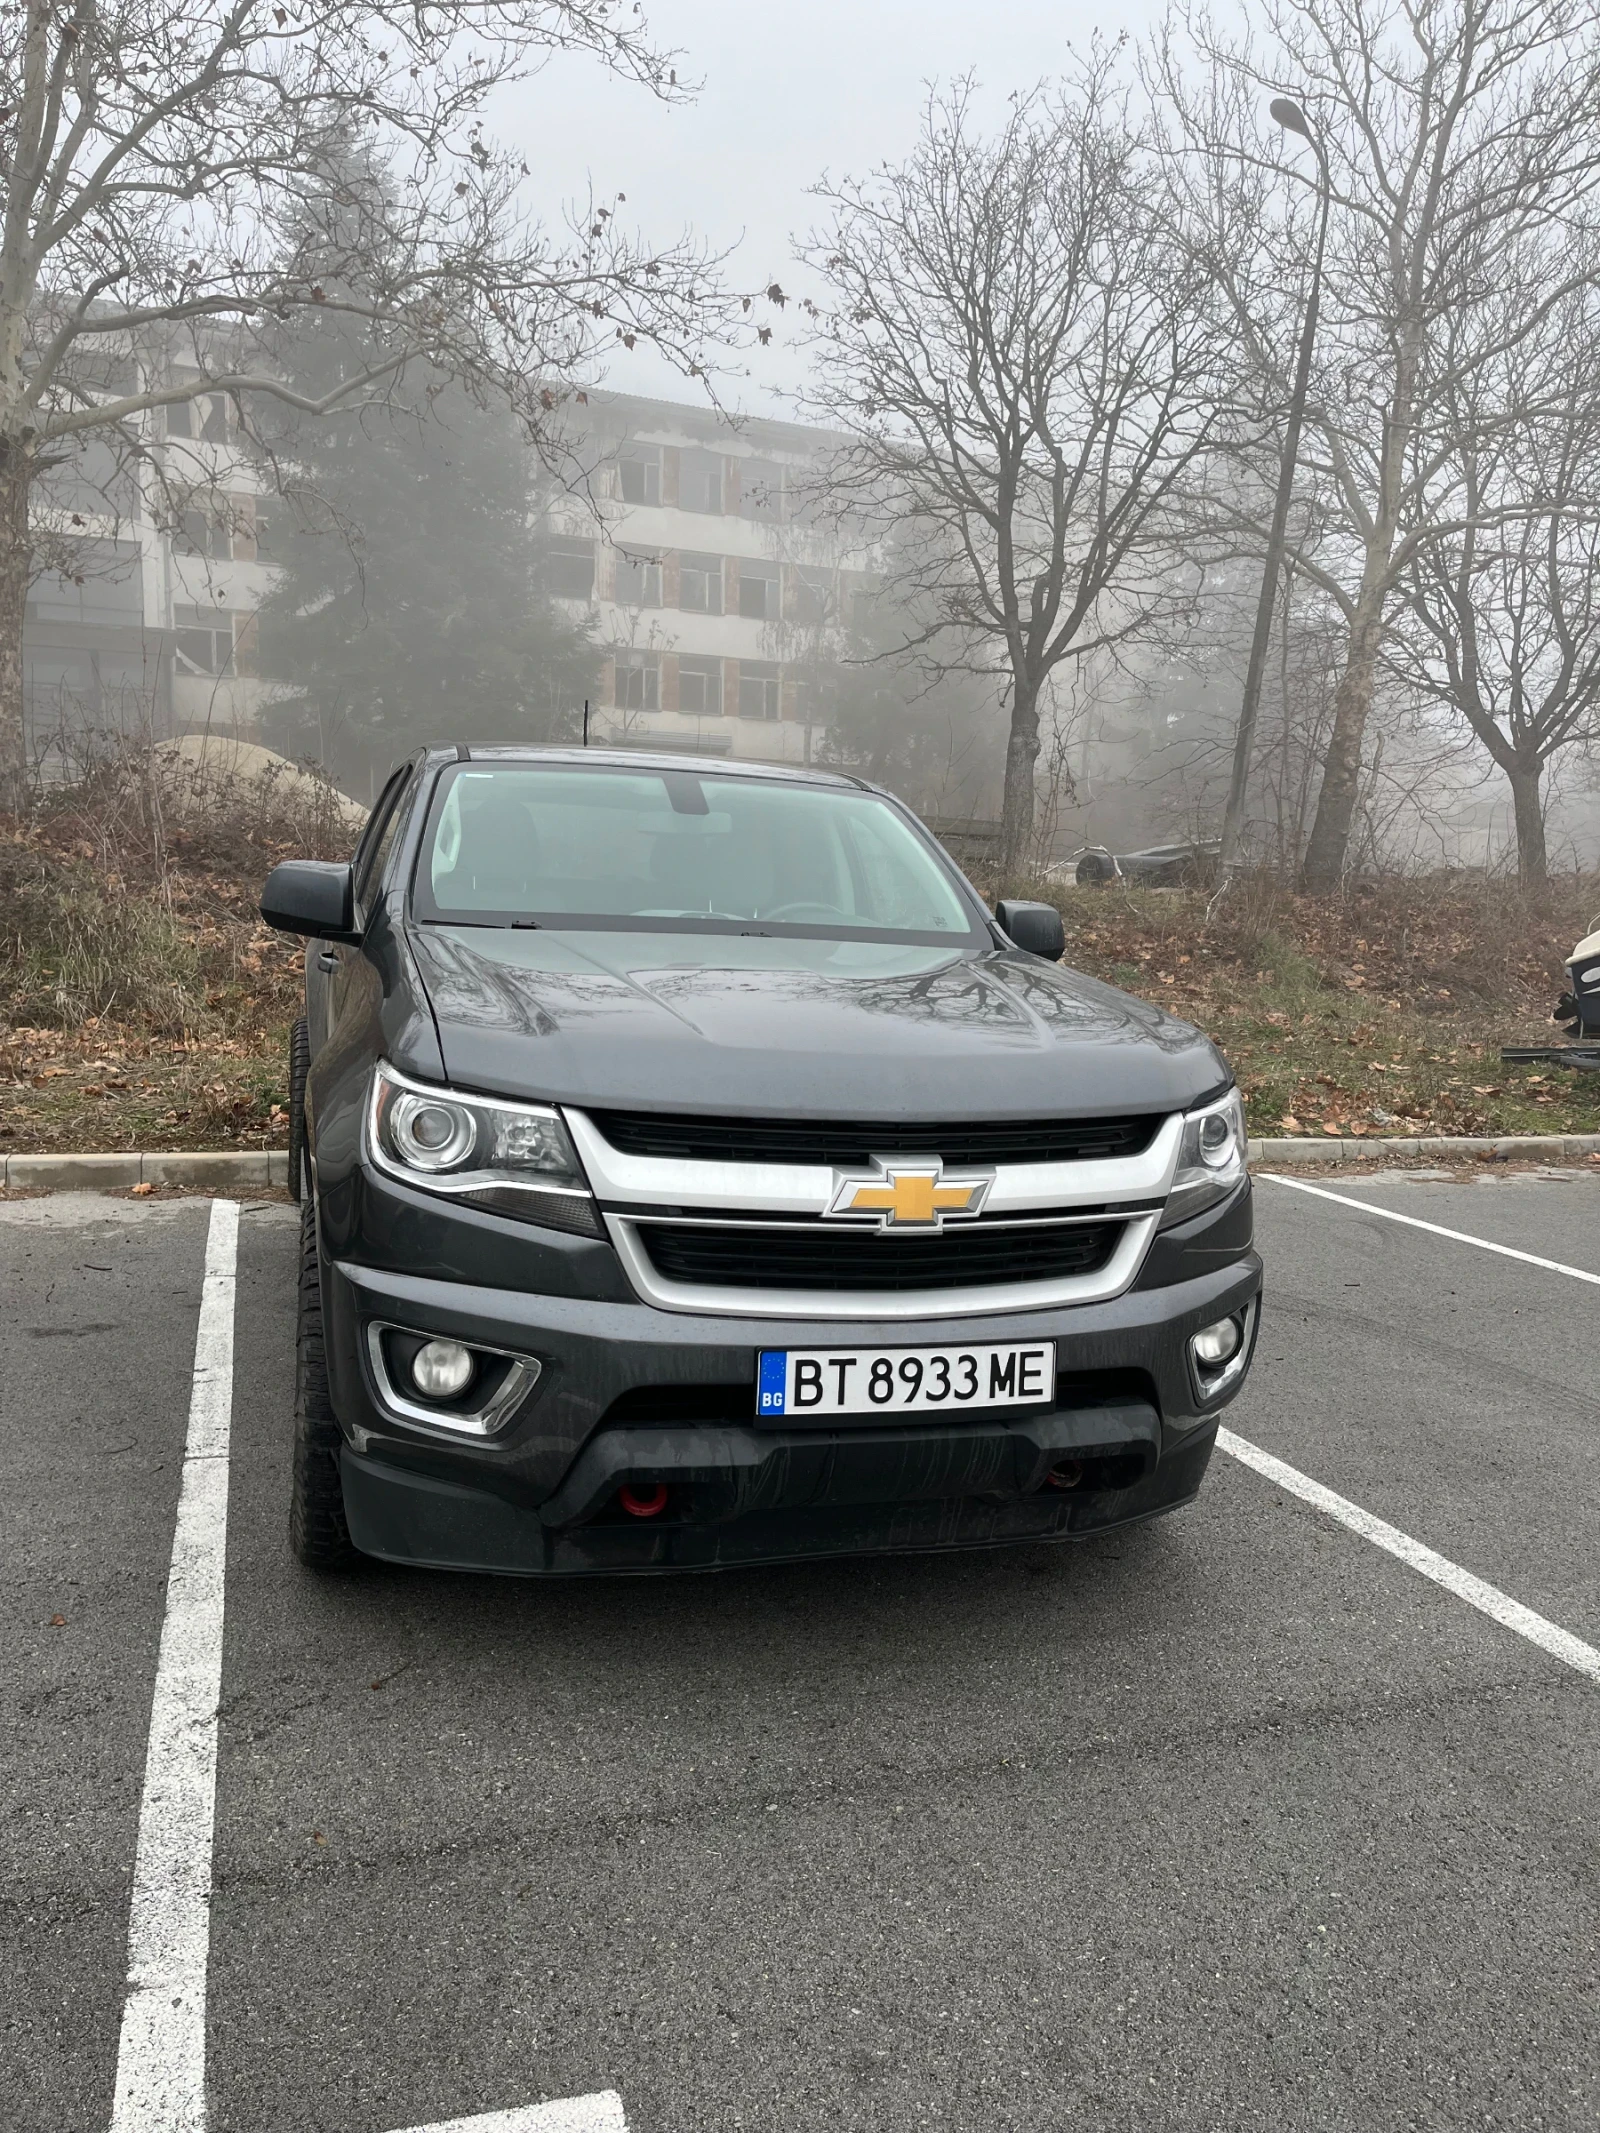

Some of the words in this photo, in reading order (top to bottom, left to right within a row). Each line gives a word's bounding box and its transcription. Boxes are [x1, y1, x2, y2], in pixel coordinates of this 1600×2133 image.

[793, 1358, 857, 1407] BT
[868, 1354, 978, 1404] 8933
[989, 1350, 1044, 1398] ME
[762, 1392, 783, 1407] BG
